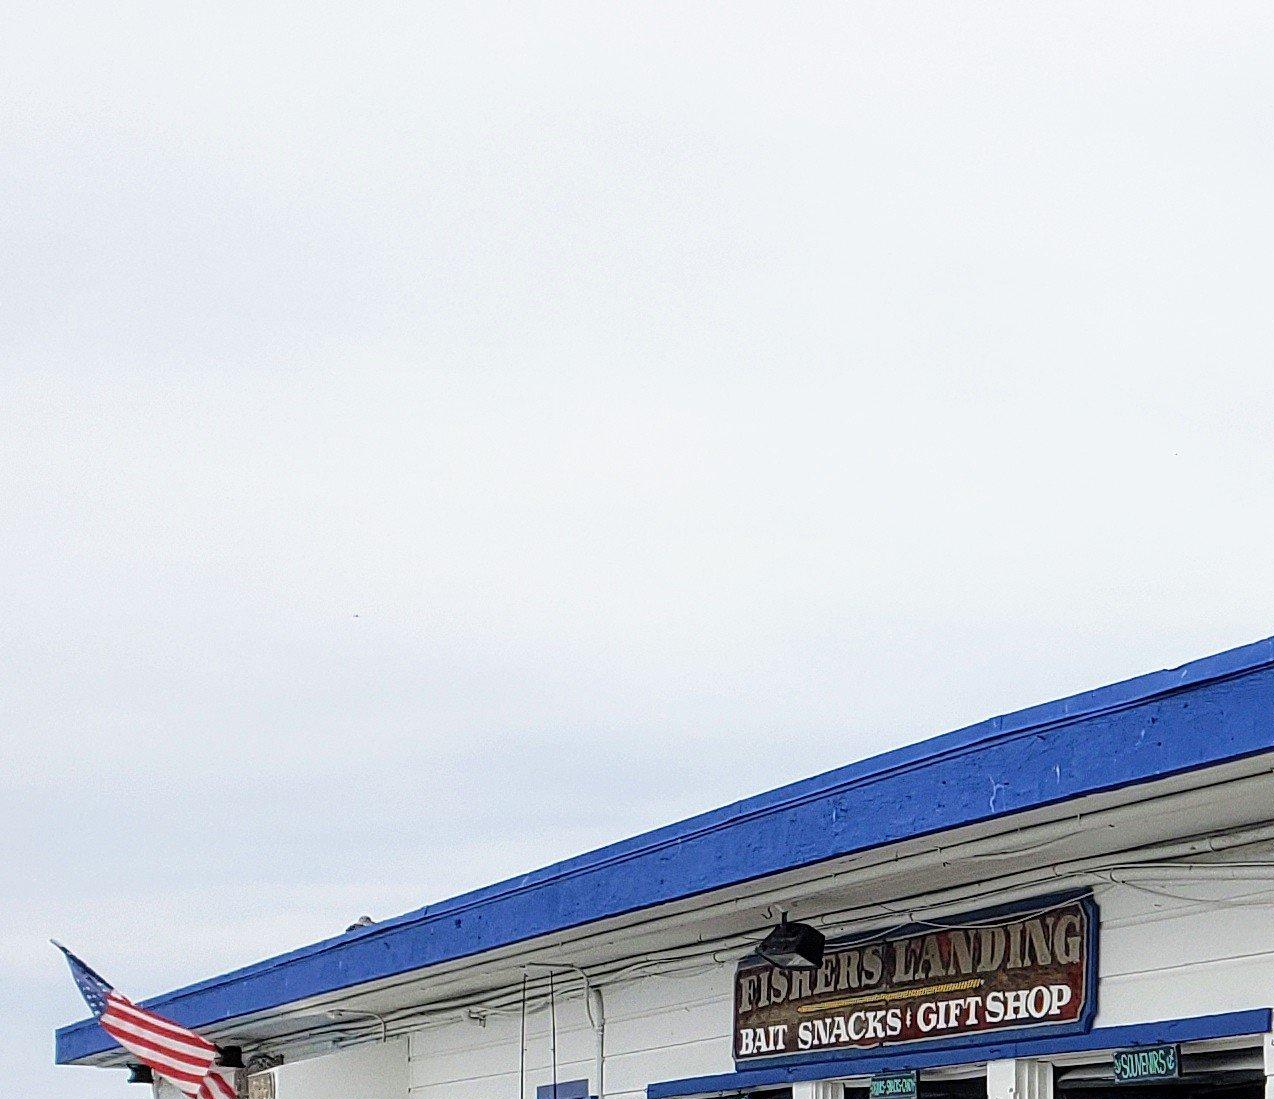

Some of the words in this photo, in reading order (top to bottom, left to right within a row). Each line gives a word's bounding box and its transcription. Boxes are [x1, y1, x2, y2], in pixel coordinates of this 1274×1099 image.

[893, 915, 1083, 983] LANDING
[739, 1025, 788, 1055] BAIT
[798, 1008, 901, 1049] SNACKS
[917, 996, 982, 1032] GIFT
[985, 984, 1072, 1023] SHOP
[1121, 1050, 1167, 1078] SOUVENIRS
